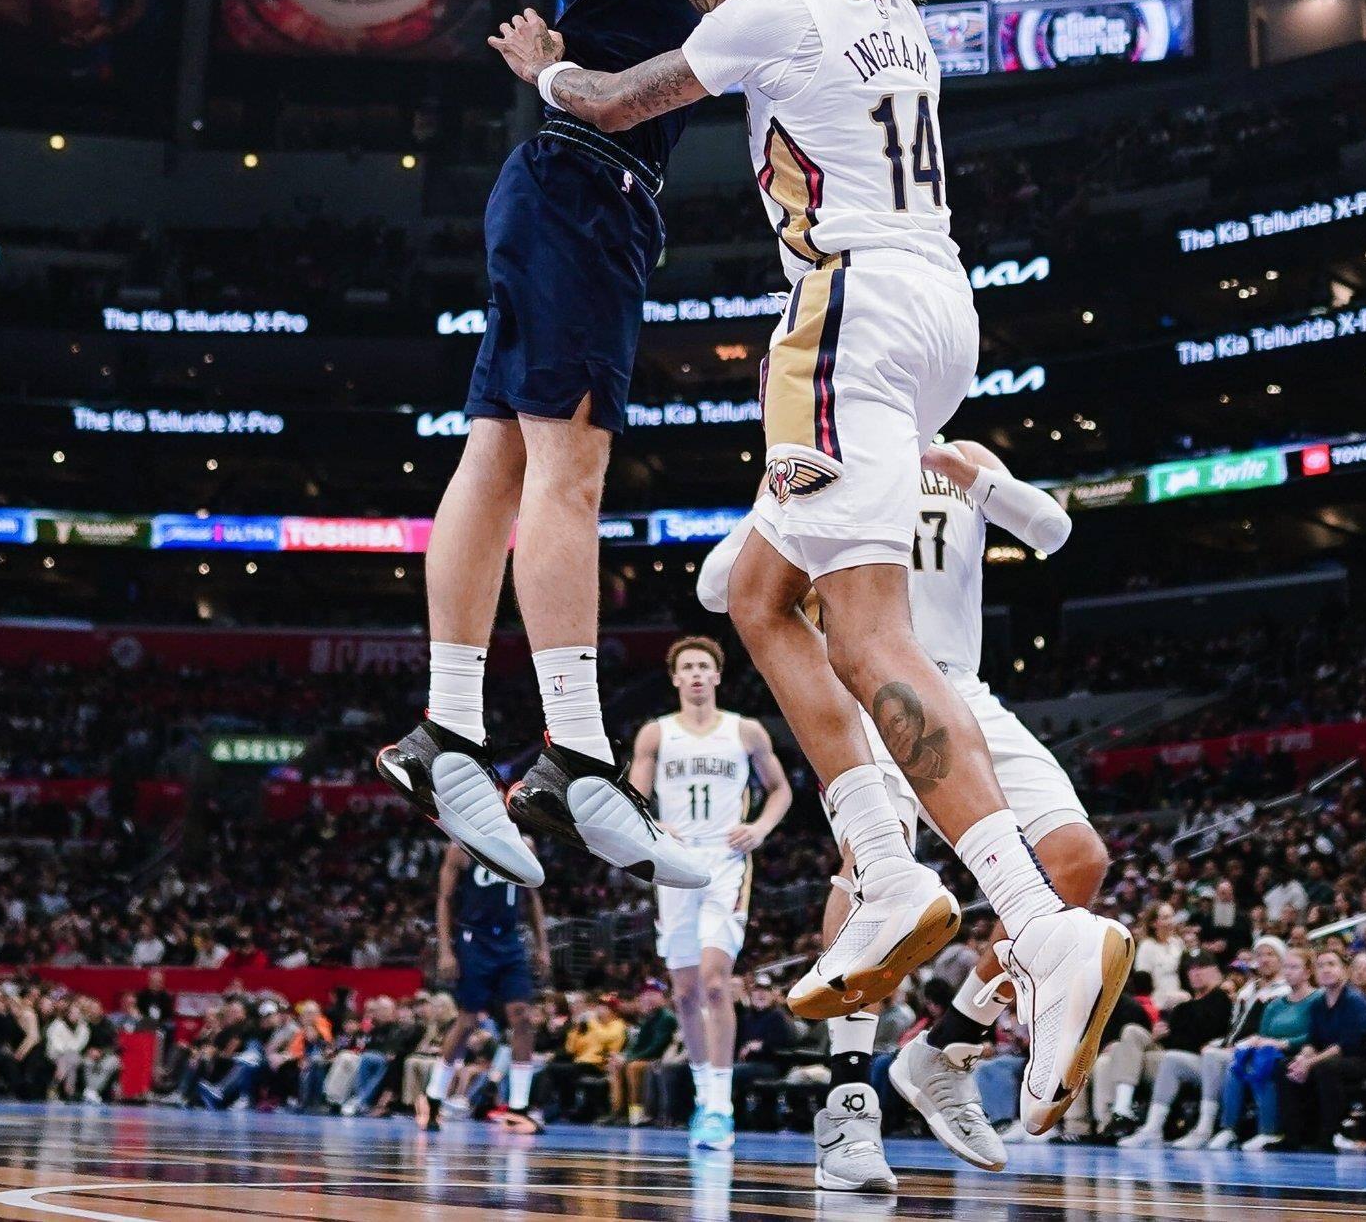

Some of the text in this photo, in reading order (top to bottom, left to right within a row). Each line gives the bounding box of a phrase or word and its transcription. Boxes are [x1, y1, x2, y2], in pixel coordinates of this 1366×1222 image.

[843, 30, 930, 83] INGRAM
[868, 91, 944, 213] 14
[1179, 229, 1216, 252] The
[1216, 220, 1250, 245] Kia
[1250, 202, 1333, 237] Telluride
[103, 307, 308, 333] The Kia Telluride X-Pro
[642, 300, 677, 323] The
[678, 300, 711, 321] Kia
[1177, 341, 1215, 365] The
[1215, 334, 1250, 359] Kia
[1251, 318, 1335, 352] Telluride
[73, 407, 284, 434] The Kia Telluride X-Pro
[624, 404, 663, 427] The
[664, 404, 697, 425] Kia
[1208, 456, 1268, 487] Sprite
[285, 519, 404, 550] TOSHIBA
[688, 783, 710, 820] 11
